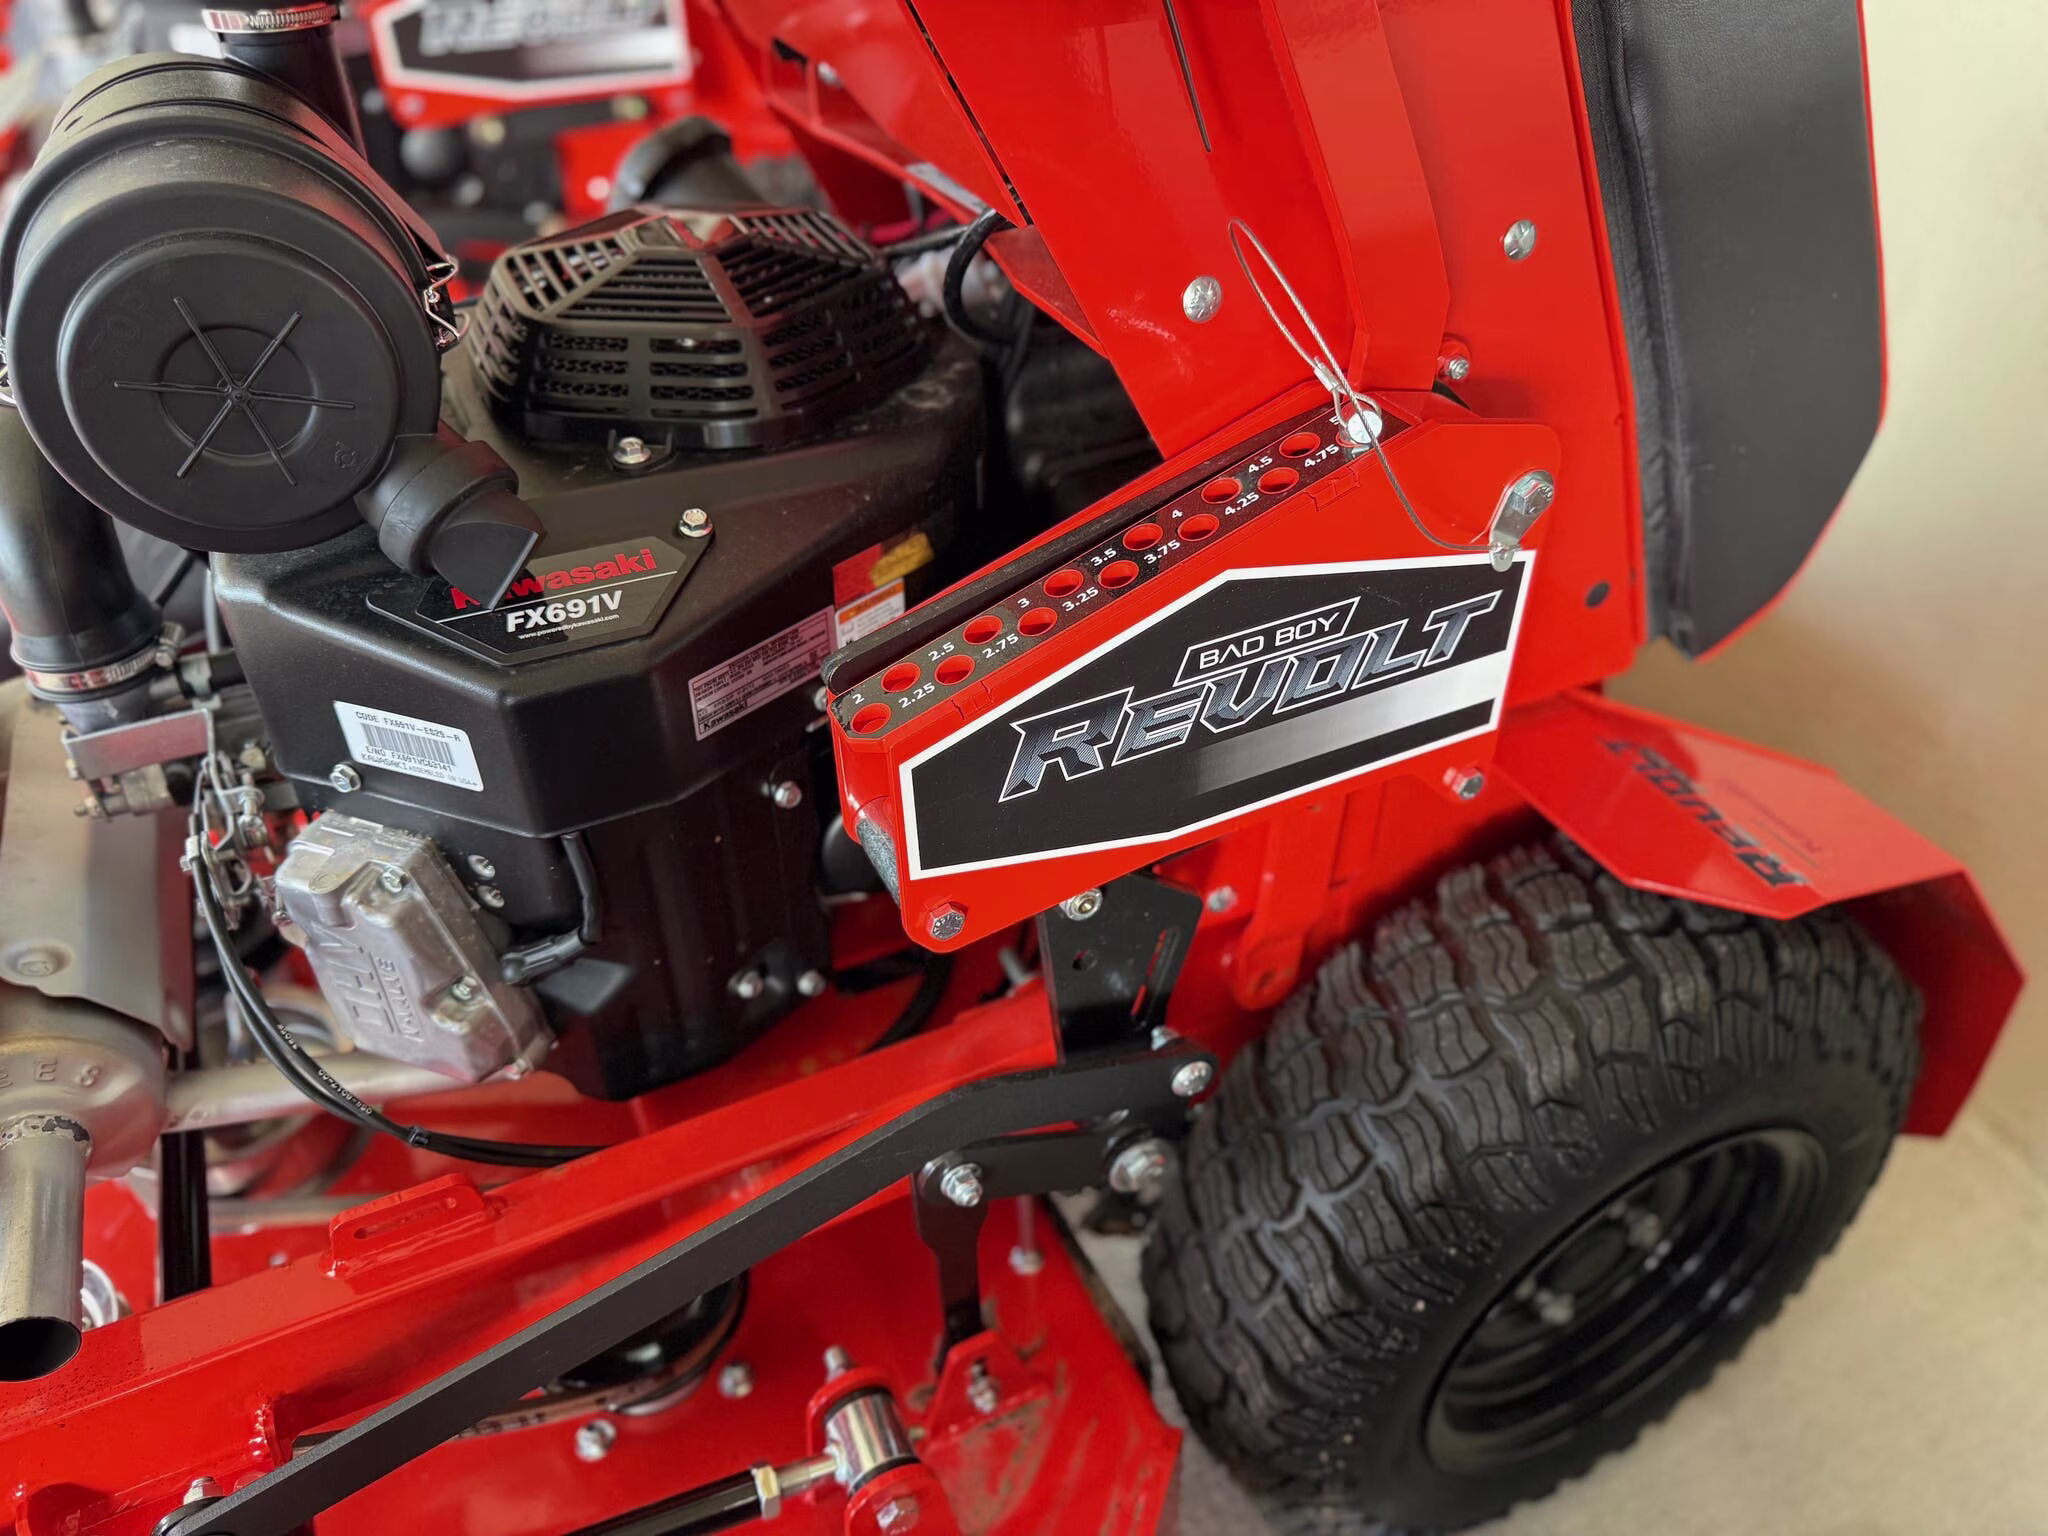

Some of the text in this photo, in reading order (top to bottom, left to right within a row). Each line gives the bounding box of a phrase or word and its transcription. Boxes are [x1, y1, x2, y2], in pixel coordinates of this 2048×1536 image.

[1248, 456, 1273, 474] 4.5
[1304, 444, 1339, 468] 4.75
[1172, 509, 1183, 519] 4
[1224, 492, 1260, 516] 4.25
[1090, 548, 1117, 567] 3.5
[1144, 540, 1181, 565] 3.75
[450, 548, 657, 610] Kwasaki
[506, 590, 623, 633] FX691V
[1017, 597, 1031, 609] 3
[1062, 587, 1099, 612] 3.25
[518, 614, 620, 640] www.poweredbykawasaki.com
[928, 642, 955, 661] 2.5
[982, 634, 1019, 659] 2.75
[1199, 612, 1339, 670] BAD BOY
[852, 693, 865, 704] 2
[899, 683, 936, 708] 2.25
[998, 590, 1502, 802] REVOLT
[355, 711, 379, 723] CODE
